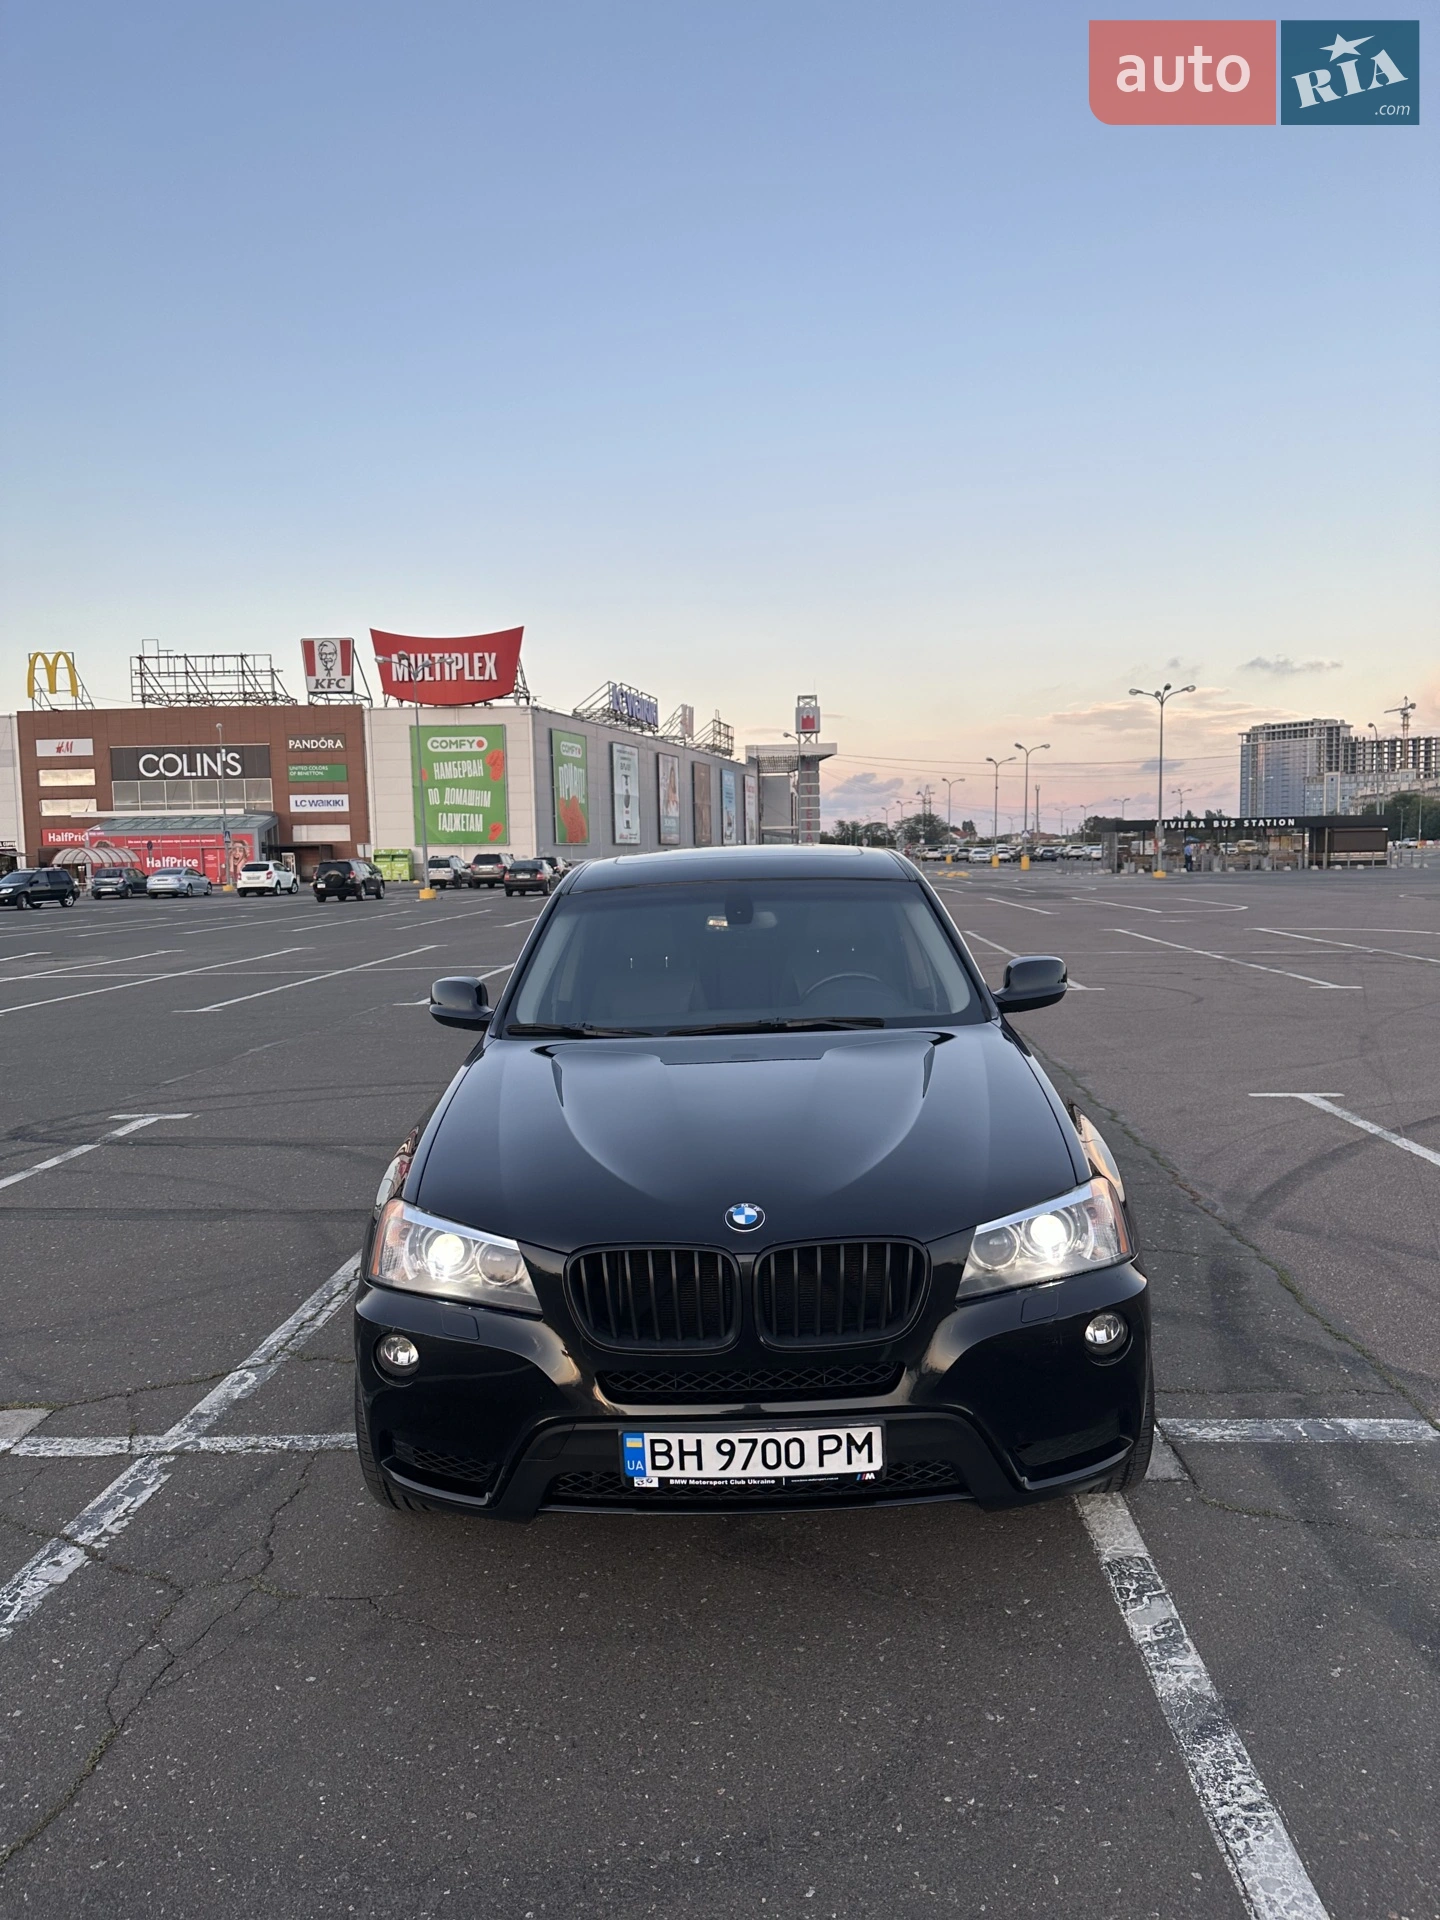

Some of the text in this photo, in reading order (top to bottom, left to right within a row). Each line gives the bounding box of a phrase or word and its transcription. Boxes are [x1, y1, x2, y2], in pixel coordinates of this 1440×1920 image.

[391, 652, 498, 682] MULTIPLEX
[314, 678, 346, 690] KFC
[56, 741, 73, 753] H&M
[288, 737, 344, 749] PANDORA
[430, 739, 476, 749] COMFY
[138, 748, 242, 777] COLIN'S
[433, 759, 484, 780] НАМБЕРВАН
[295, 799, 307, 807] LC
[428, 787, 491, 808] ПО ДОМАШНІМ
[438, 812, 483, 832] ГАДЖЕТАМ
[1213, 820, 1236, 828] BUS
[1243, 818, 1295, 827] STATION
[48, 832, 87, 843] HalfPric
[146, 857, 198, 868] HalfPrice
[650, 1431, 874, 1471] BH 9700 PM
[627, 1460, 645, 1471] UA
[689, 1478, 728, 1486] Motorsport
